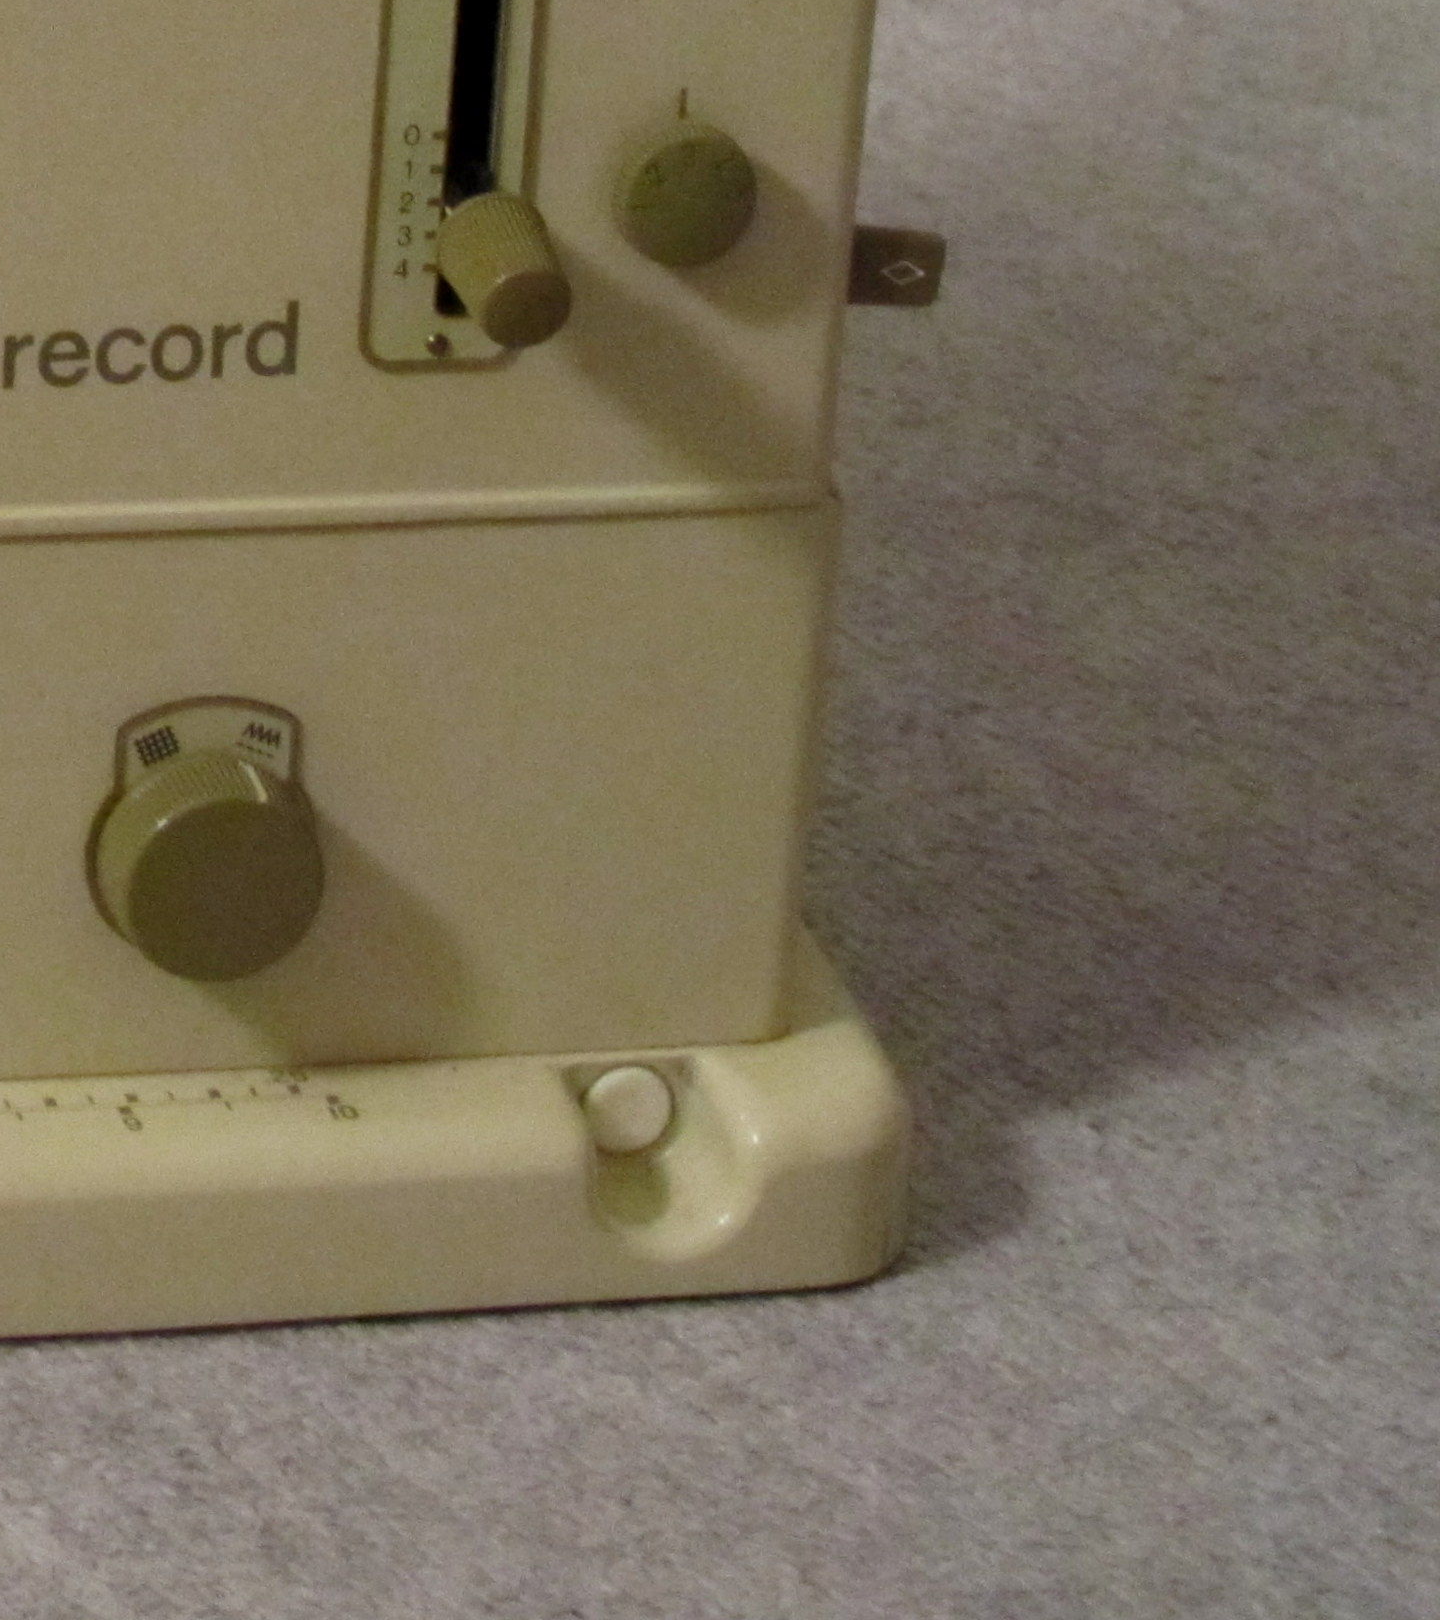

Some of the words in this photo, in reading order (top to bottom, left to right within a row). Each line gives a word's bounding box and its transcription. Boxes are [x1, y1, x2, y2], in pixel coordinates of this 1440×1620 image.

[403, 124, 421, 147] 0
[404, 159, 414, 180] 1
[398, 190, 415, 214] 2
[396, 225, 413, 247] 3
[392, 258, 409, 279] 4
[1, 299, 300, 390] record
[327, 1104, 360, 1121] 10
